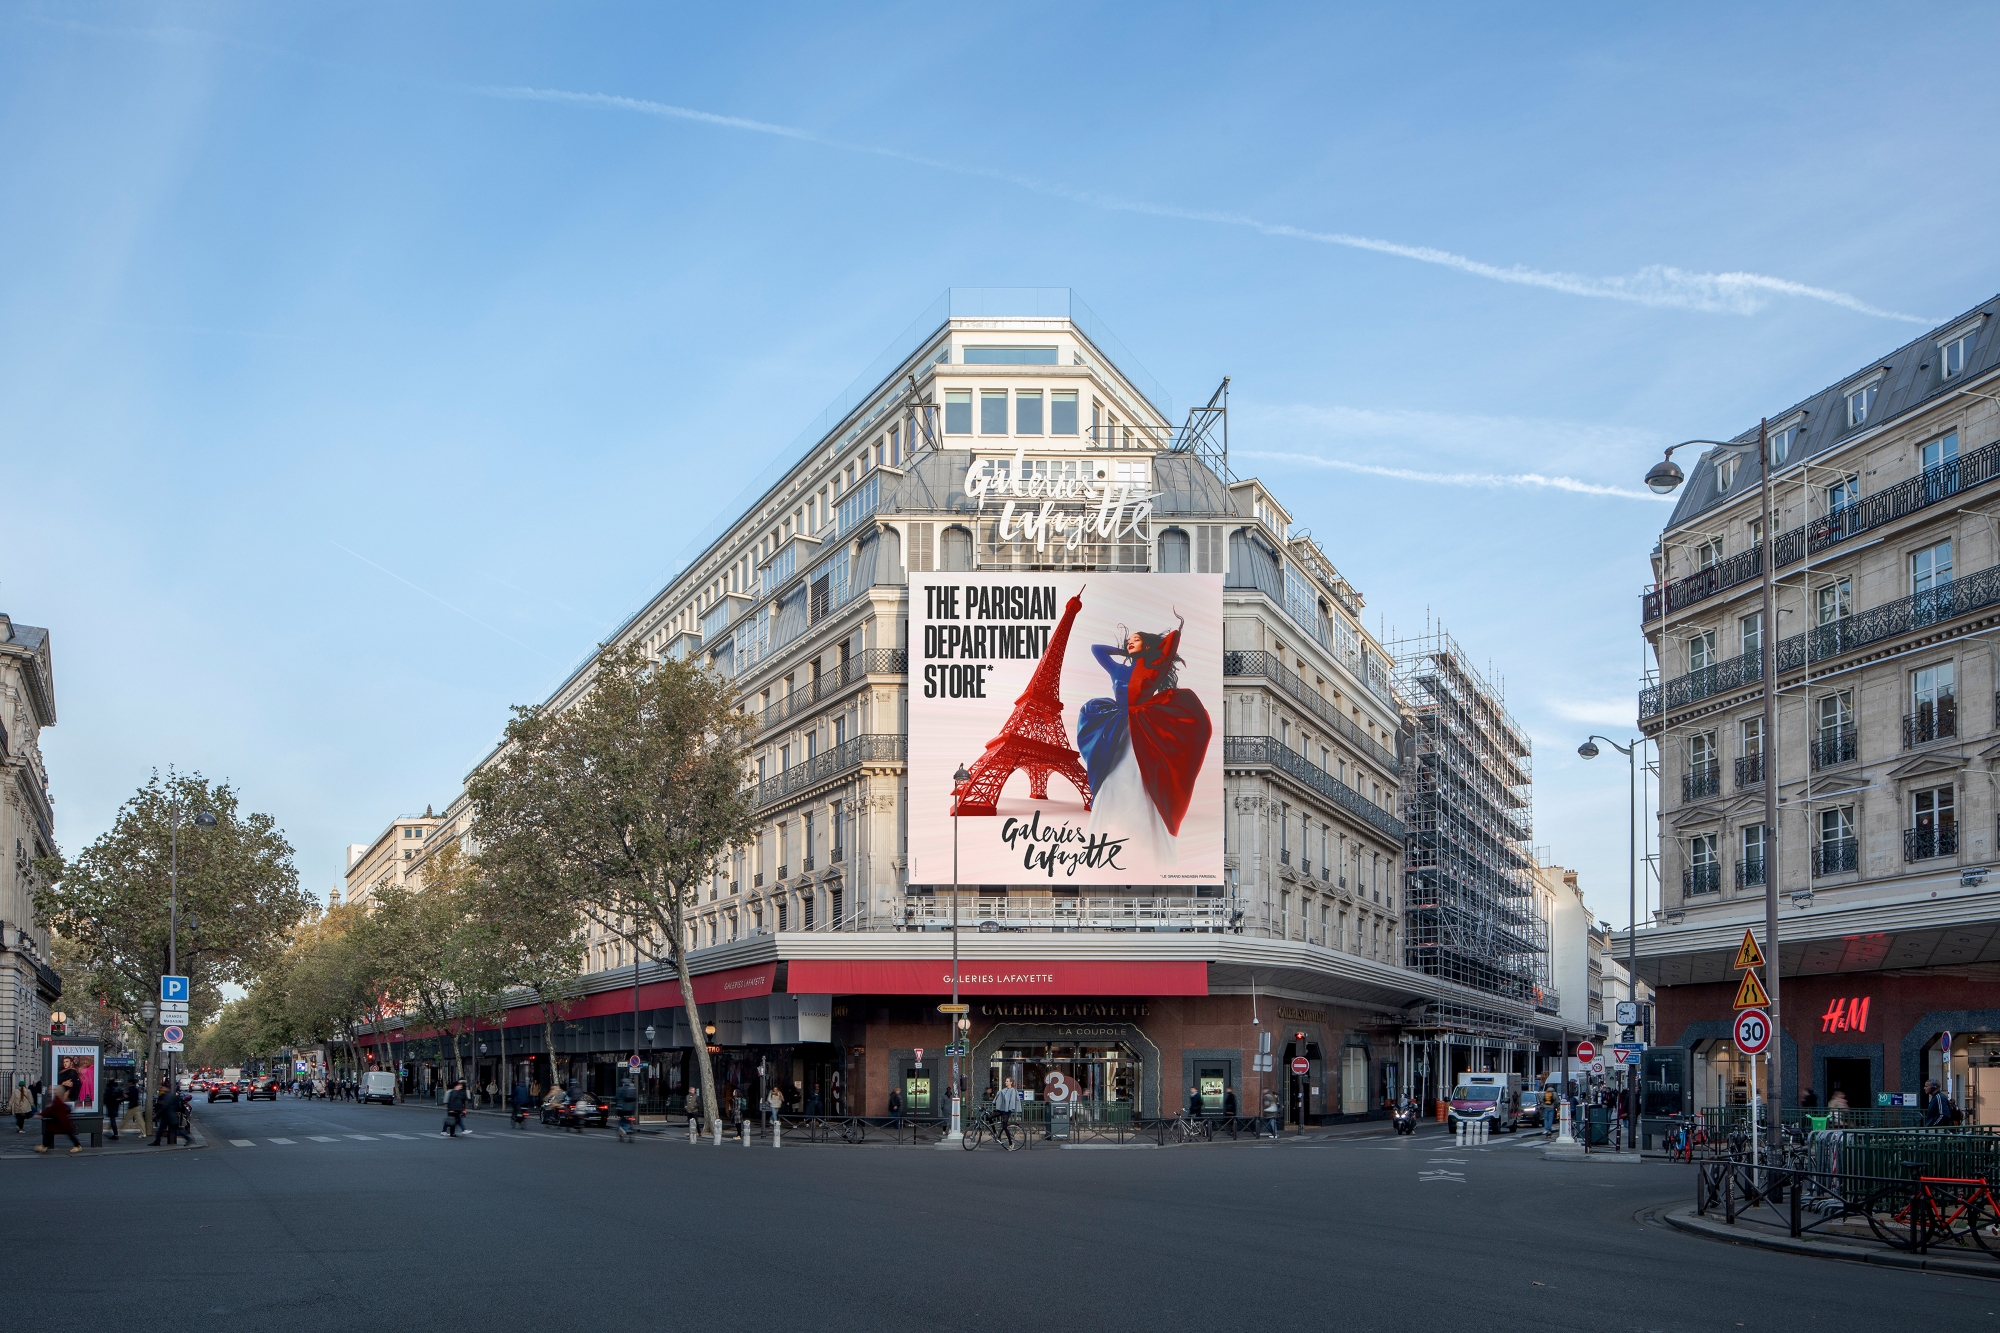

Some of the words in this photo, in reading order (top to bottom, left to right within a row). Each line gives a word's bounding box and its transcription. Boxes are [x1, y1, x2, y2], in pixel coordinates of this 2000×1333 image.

[964, 448, 1097, 509] Galeries
[999, 485, 1165, 552] Lafayette
[924, 586, 960, 620] THE
[965, 586, 1057, 620] PARISIAN
[924, 625, 1051, 659] DEPARTMENT
[1001, 810, 1086, 851] Galeries
[1023, 833, 1130, 877] Lafayette
[169, 981, 181, 997] P
[723, 980, 744, 991] GALERIES
[744, 976, 766, 988] LAFAYETTE
[997, 974, 1053, 983] LAFAYETTE
[982, 1004, 1058, 1016] GALERIES
[1063, 1004, 1150, 1016] LAFAYETTE
[1821, 996, 1871, 1034] H&M
[1076, 1028, 1127, 1036] COUPOLE
[1741, 1022, 1764, 1042] 30
[57, 1046, 96, 1054] VALENTINO
[1045, 1071, 1069, 1101] 3
[1647, 1080, 1680, 1091] Titane
